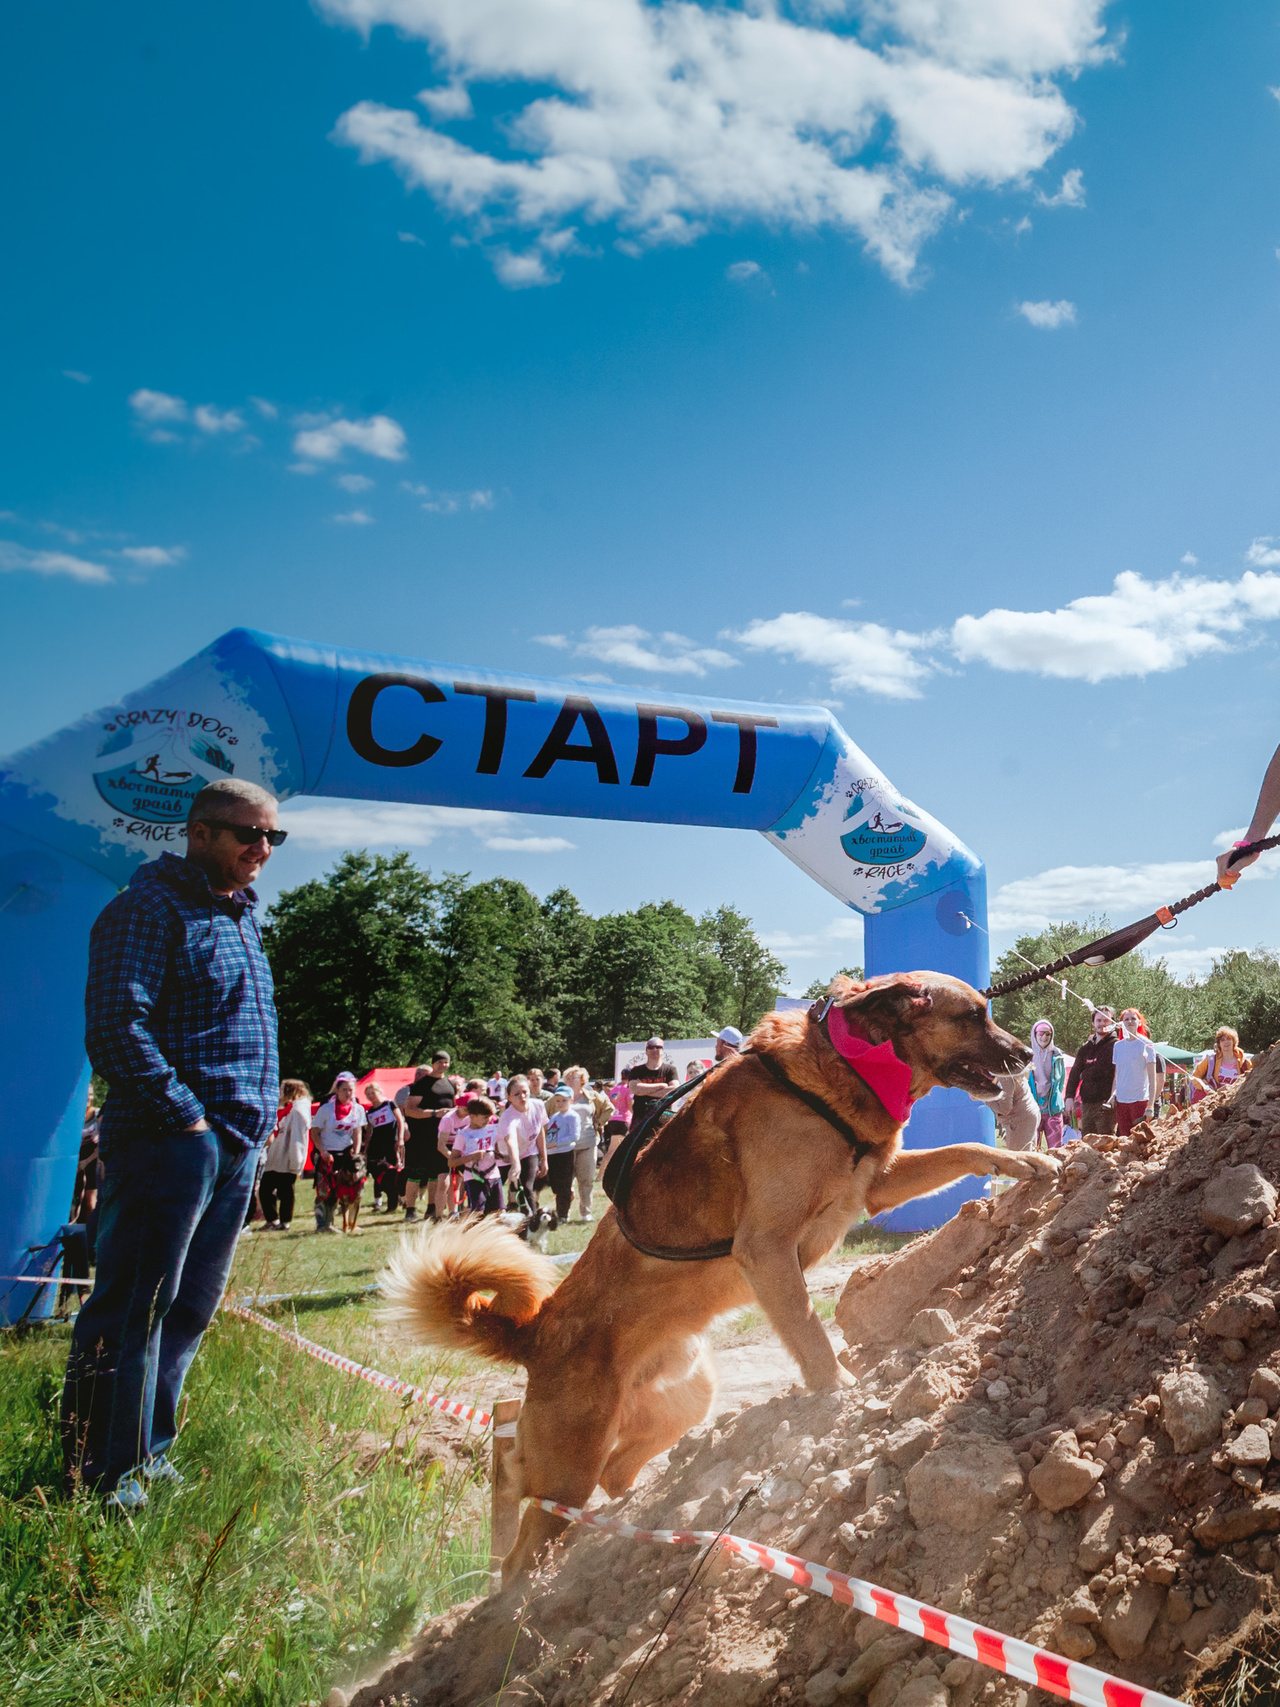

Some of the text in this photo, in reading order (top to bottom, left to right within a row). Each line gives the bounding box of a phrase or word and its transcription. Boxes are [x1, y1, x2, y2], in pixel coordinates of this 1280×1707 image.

[115, 709, 233, 739] CRAZY DOG
[346, 672, 780, 794] СТАРТ
[108, 777, 199, 800] хвостаты
[850, 777, 879, 794] CRAZY
[132, 796, 183, 814] драйв
[126, 821, 176, 842] RACE
[851, 833, 918, 845] хвостатый
[869, 844, 905, 860] драйв
[864, 864, 907, 880] RACE
